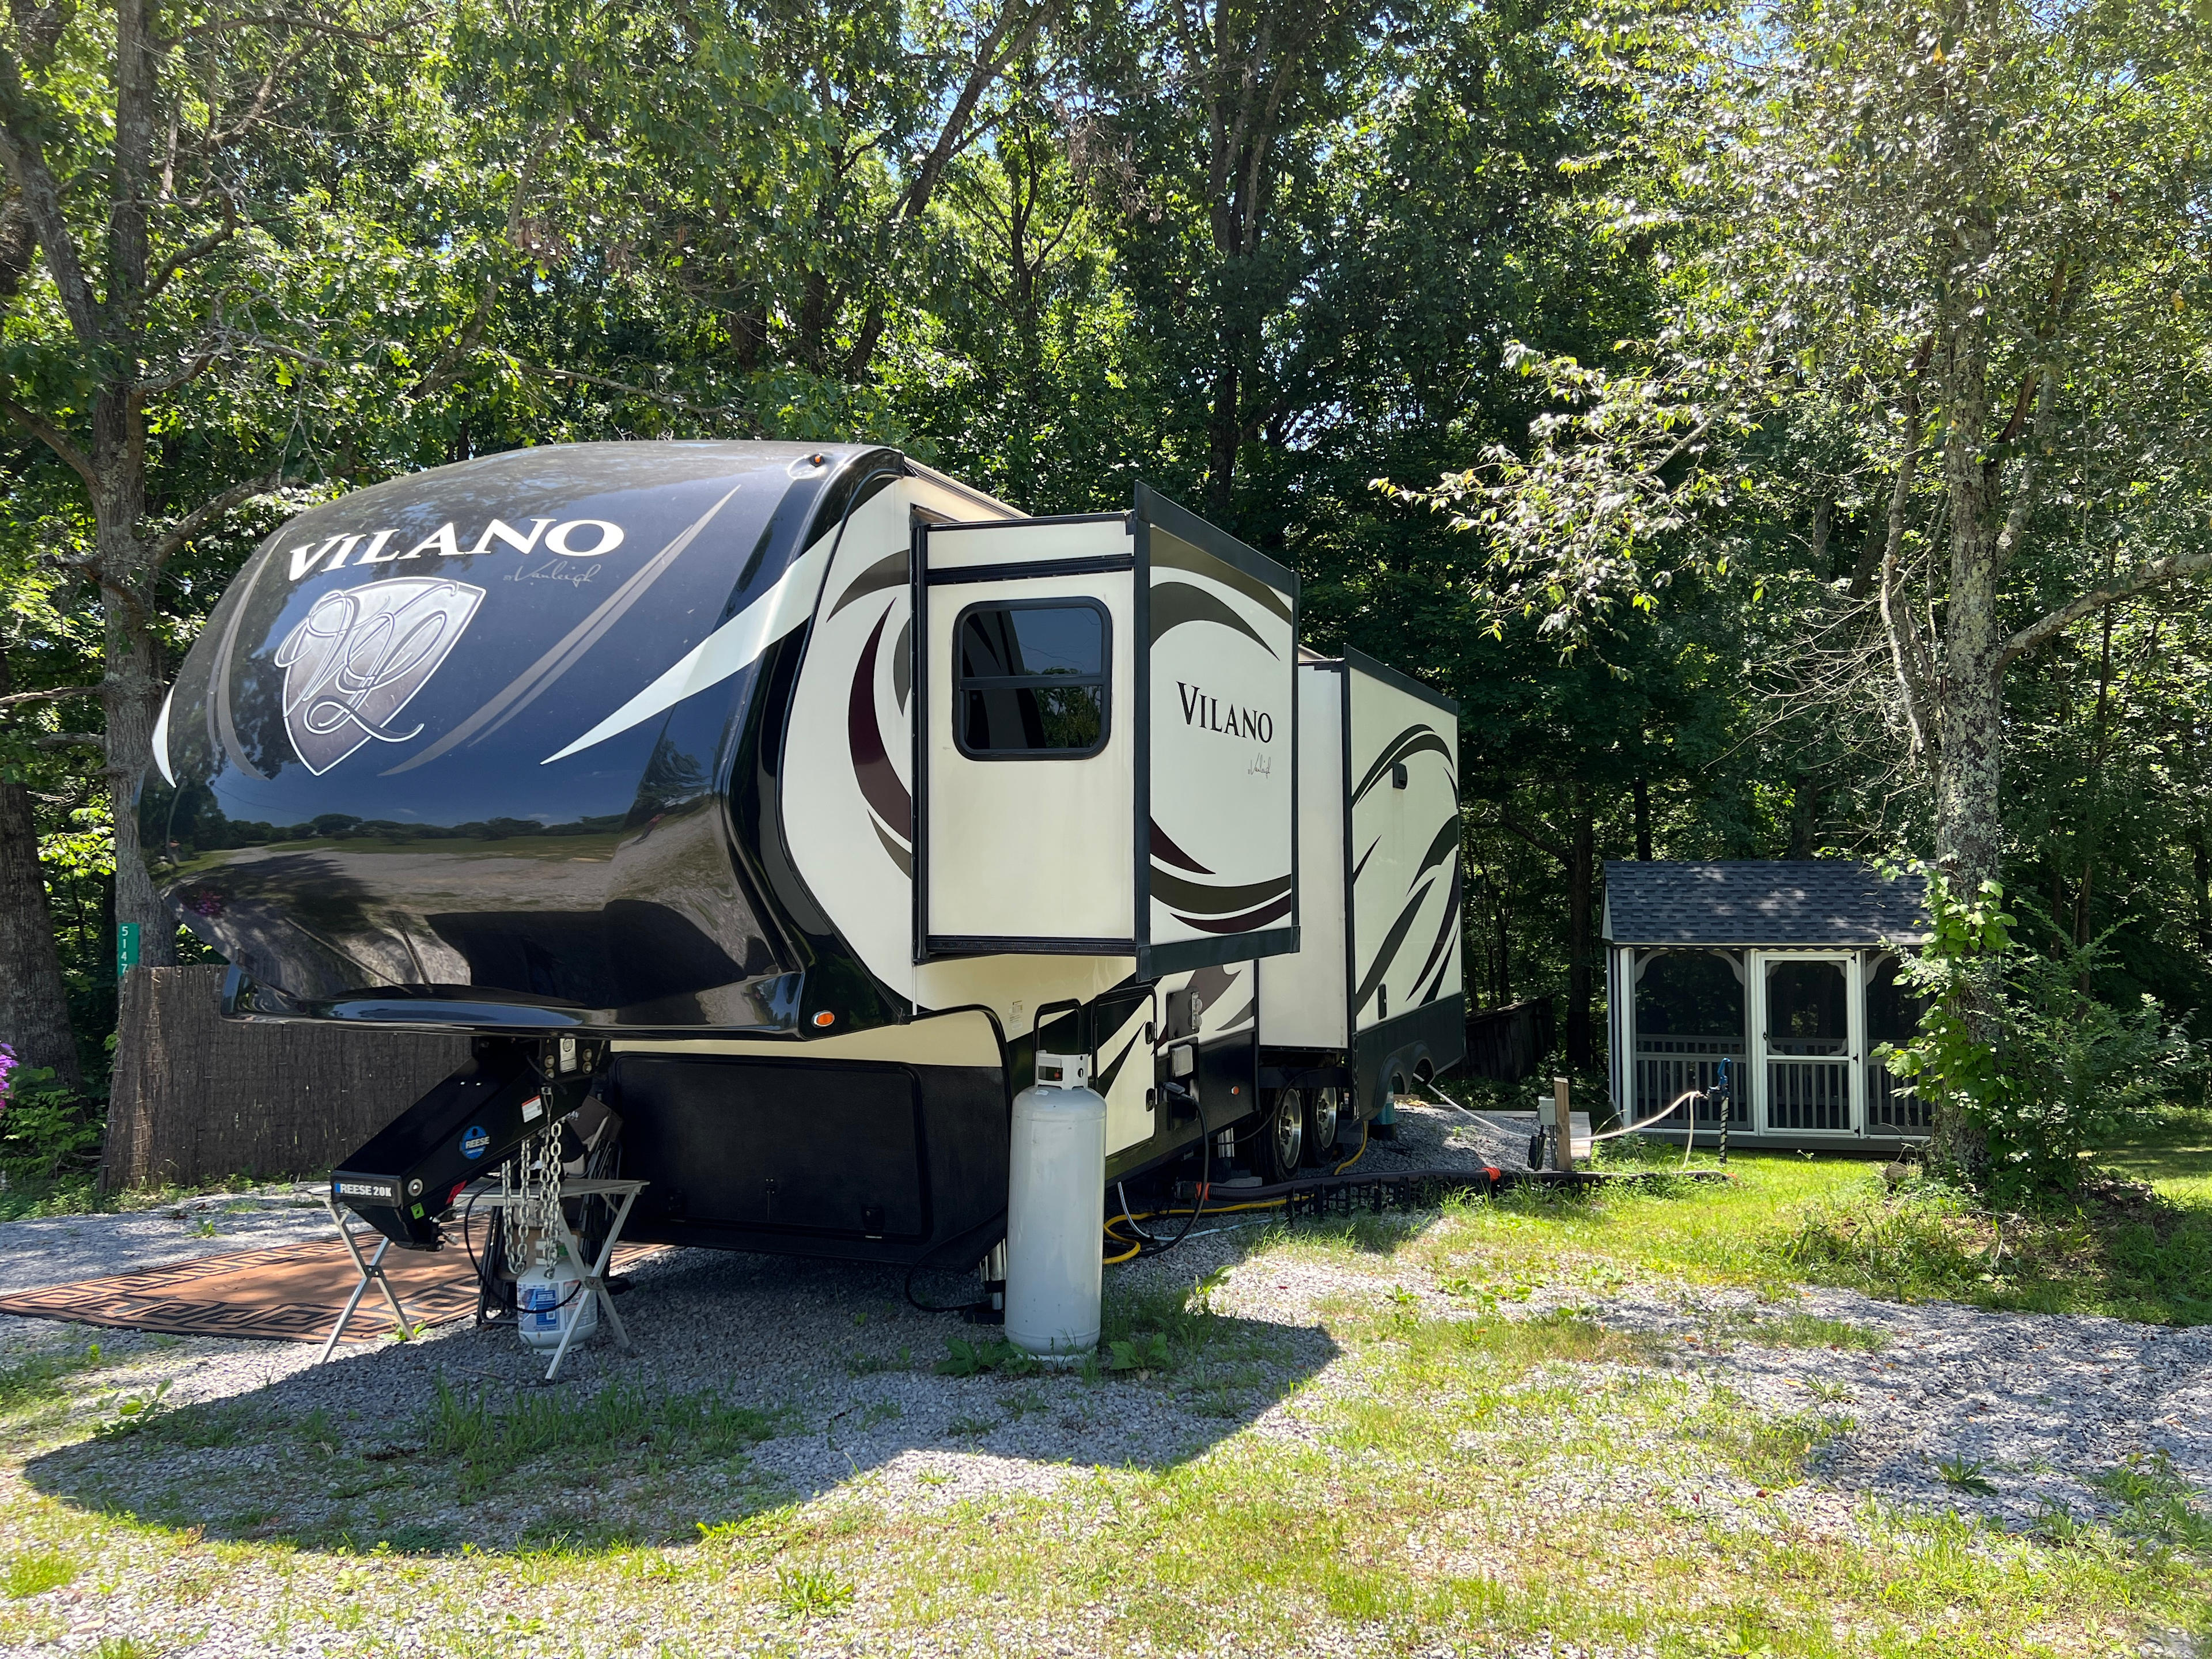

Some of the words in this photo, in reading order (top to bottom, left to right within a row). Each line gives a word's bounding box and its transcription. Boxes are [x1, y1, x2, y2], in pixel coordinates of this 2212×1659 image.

[289, 518, 624, 582] VILANO
[1176, 680, 1273, 743] VILANO
[465, 1136, 490, 1149] REESE
[340, 1183, 372, 1196] REESE
[373, 1185, 392, 1197] 20K
